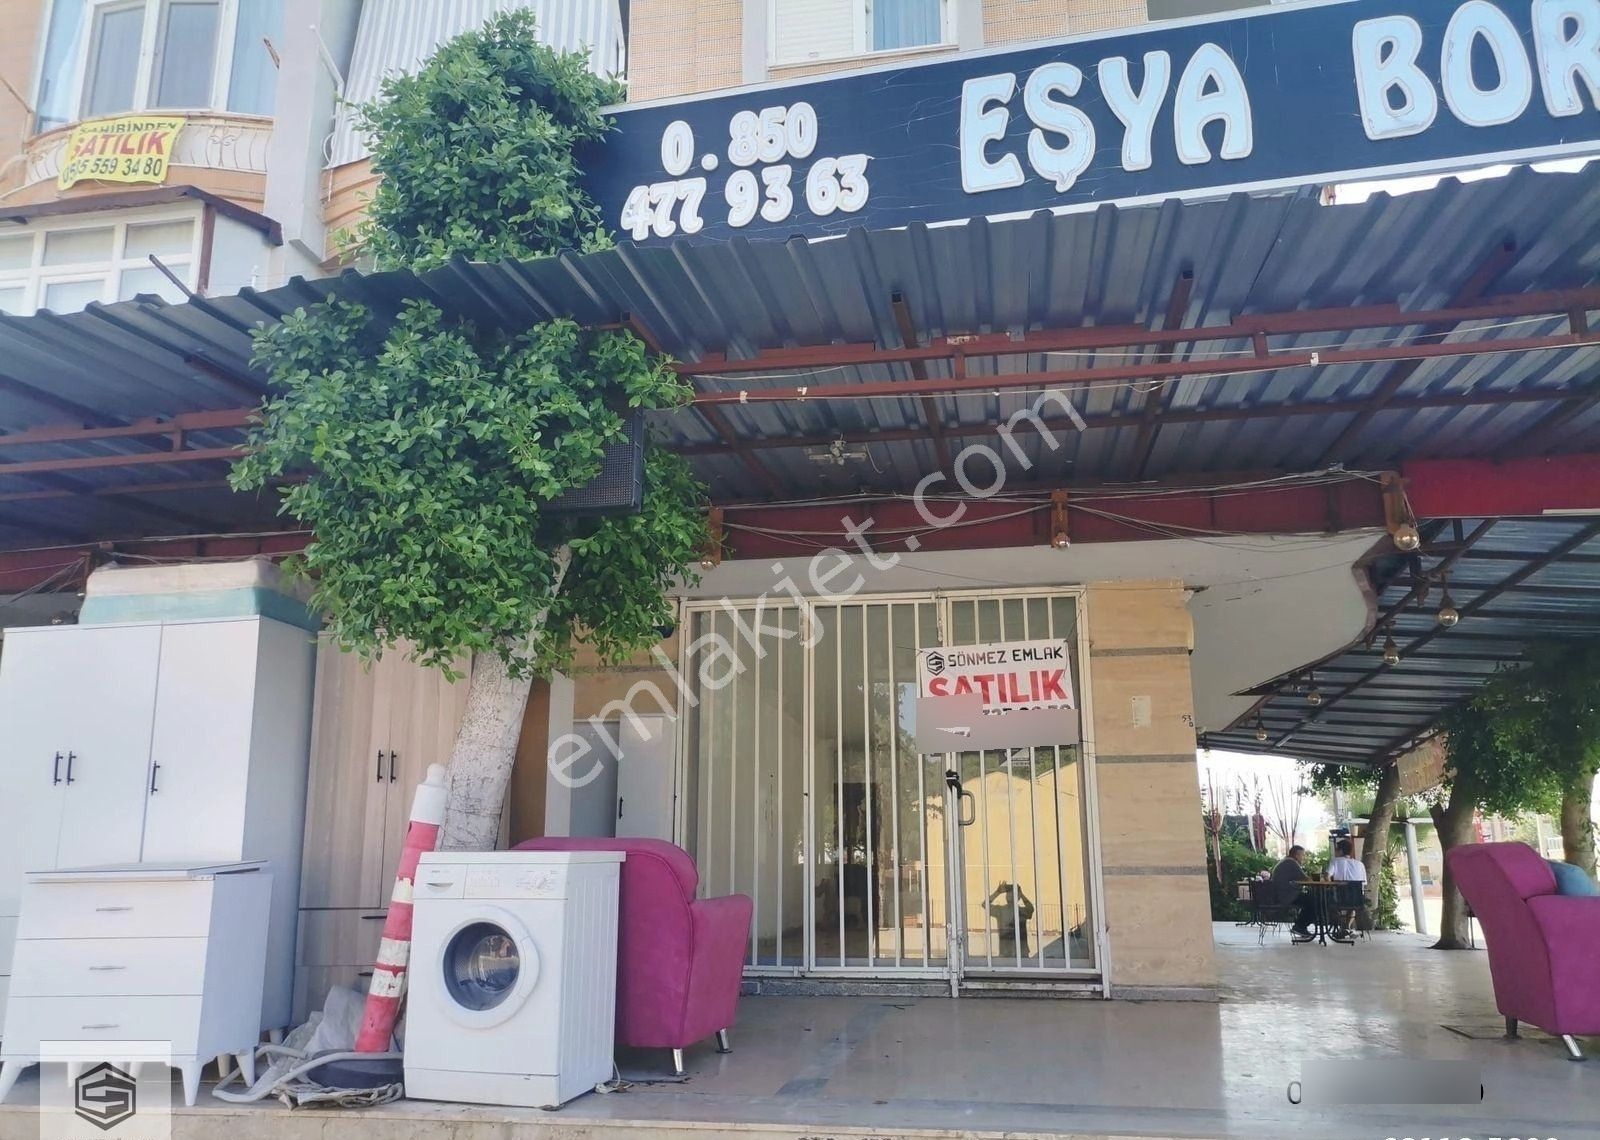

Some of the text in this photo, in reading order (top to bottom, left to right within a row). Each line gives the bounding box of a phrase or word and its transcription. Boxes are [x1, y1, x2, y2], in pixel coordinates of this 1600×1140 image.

[960, 42, 1253, 194] EŞYA
[90, 157, 118, 174] 559
[142, 157, 162, 177] 80
[621, 177, 706, 241] 477
[806, 154, 869, 216] 63
[948, 646, 1063, 667] SÖNMEZ EMLAK
[929, 669, 1068, 704] SATILIK
